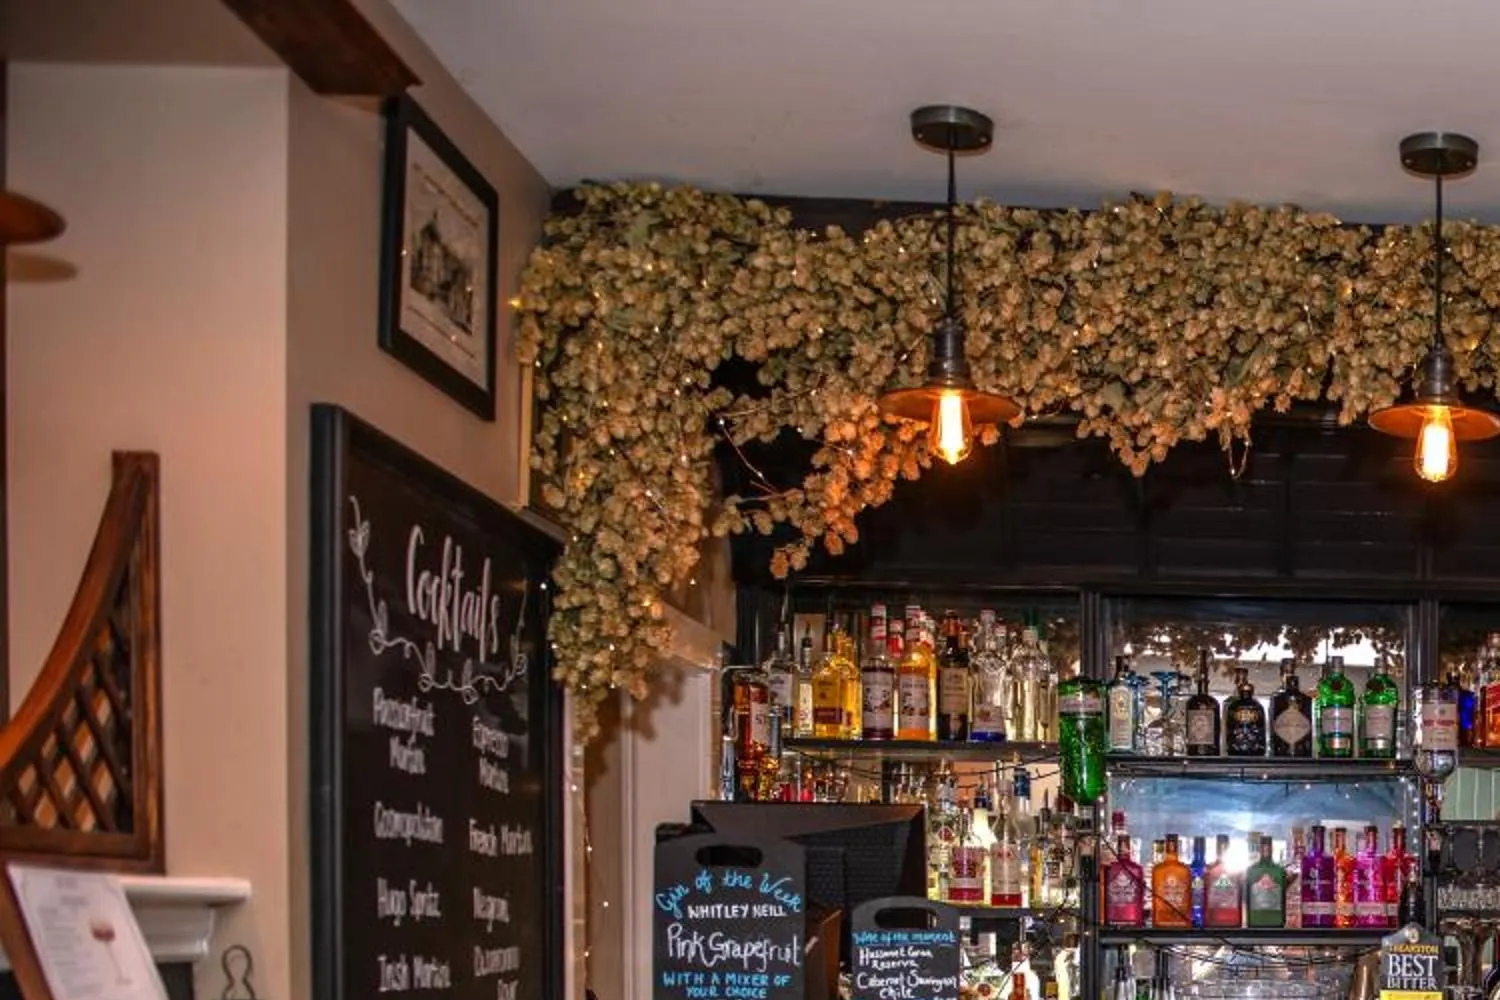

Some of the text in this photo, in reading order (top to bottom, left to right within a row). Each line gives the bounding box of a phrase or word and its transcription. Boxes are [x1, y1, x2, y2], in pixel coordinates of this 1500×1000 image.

[405, 524, 500, 663] Cocktails
[723, 869, 752, 888] the
[688, 903, 788, 919] WHITLEY NEILL
[667, 923, 801, 972] Pink Grapefruit
[1387, 954, 1439, 977] BEST
[663, 971, 792, 987] WITH A MIXER OF
[686, 987, 768, 998] YOUR CHOICE
